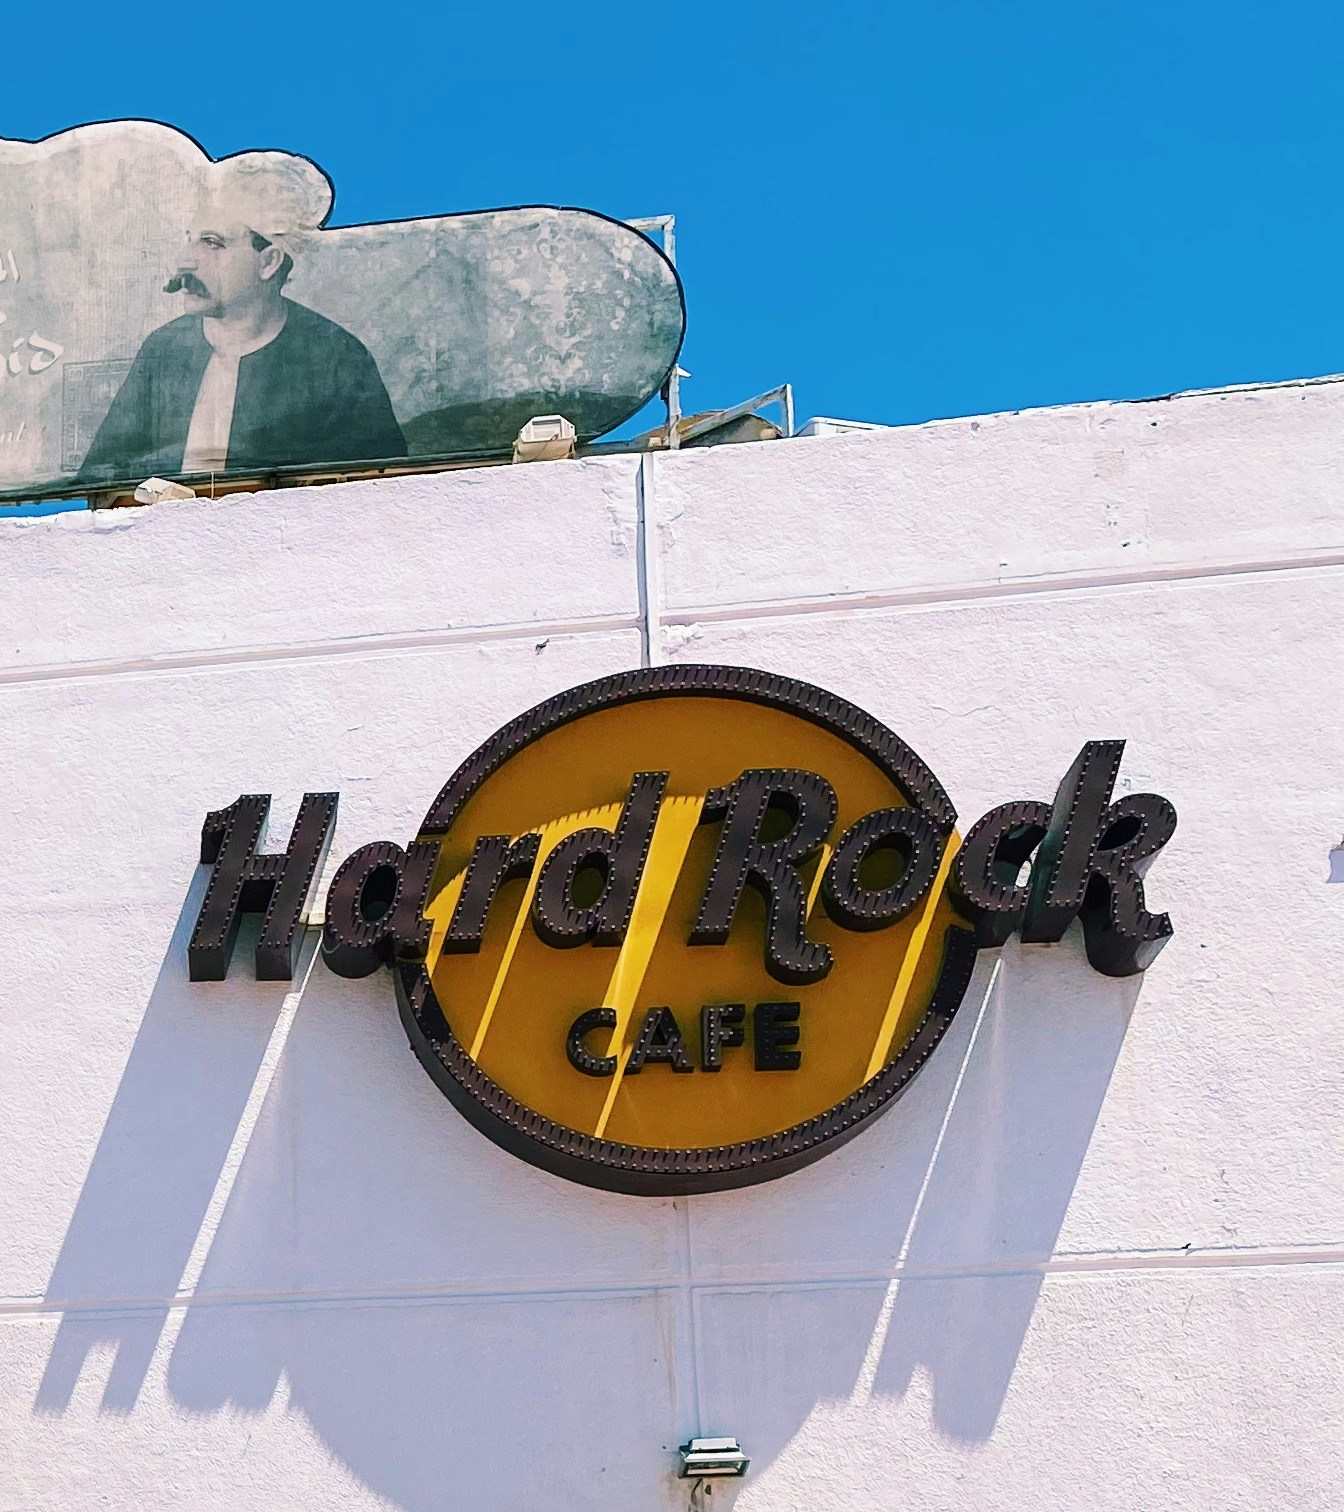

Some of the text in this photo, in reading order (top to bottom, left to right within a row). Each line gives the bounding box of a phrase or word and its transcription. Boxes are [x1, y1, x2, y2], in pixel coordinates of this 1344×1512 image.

[188, 738, 1180, 985] Hard Rock
[565, 1000, 802, 1076] CAFE
